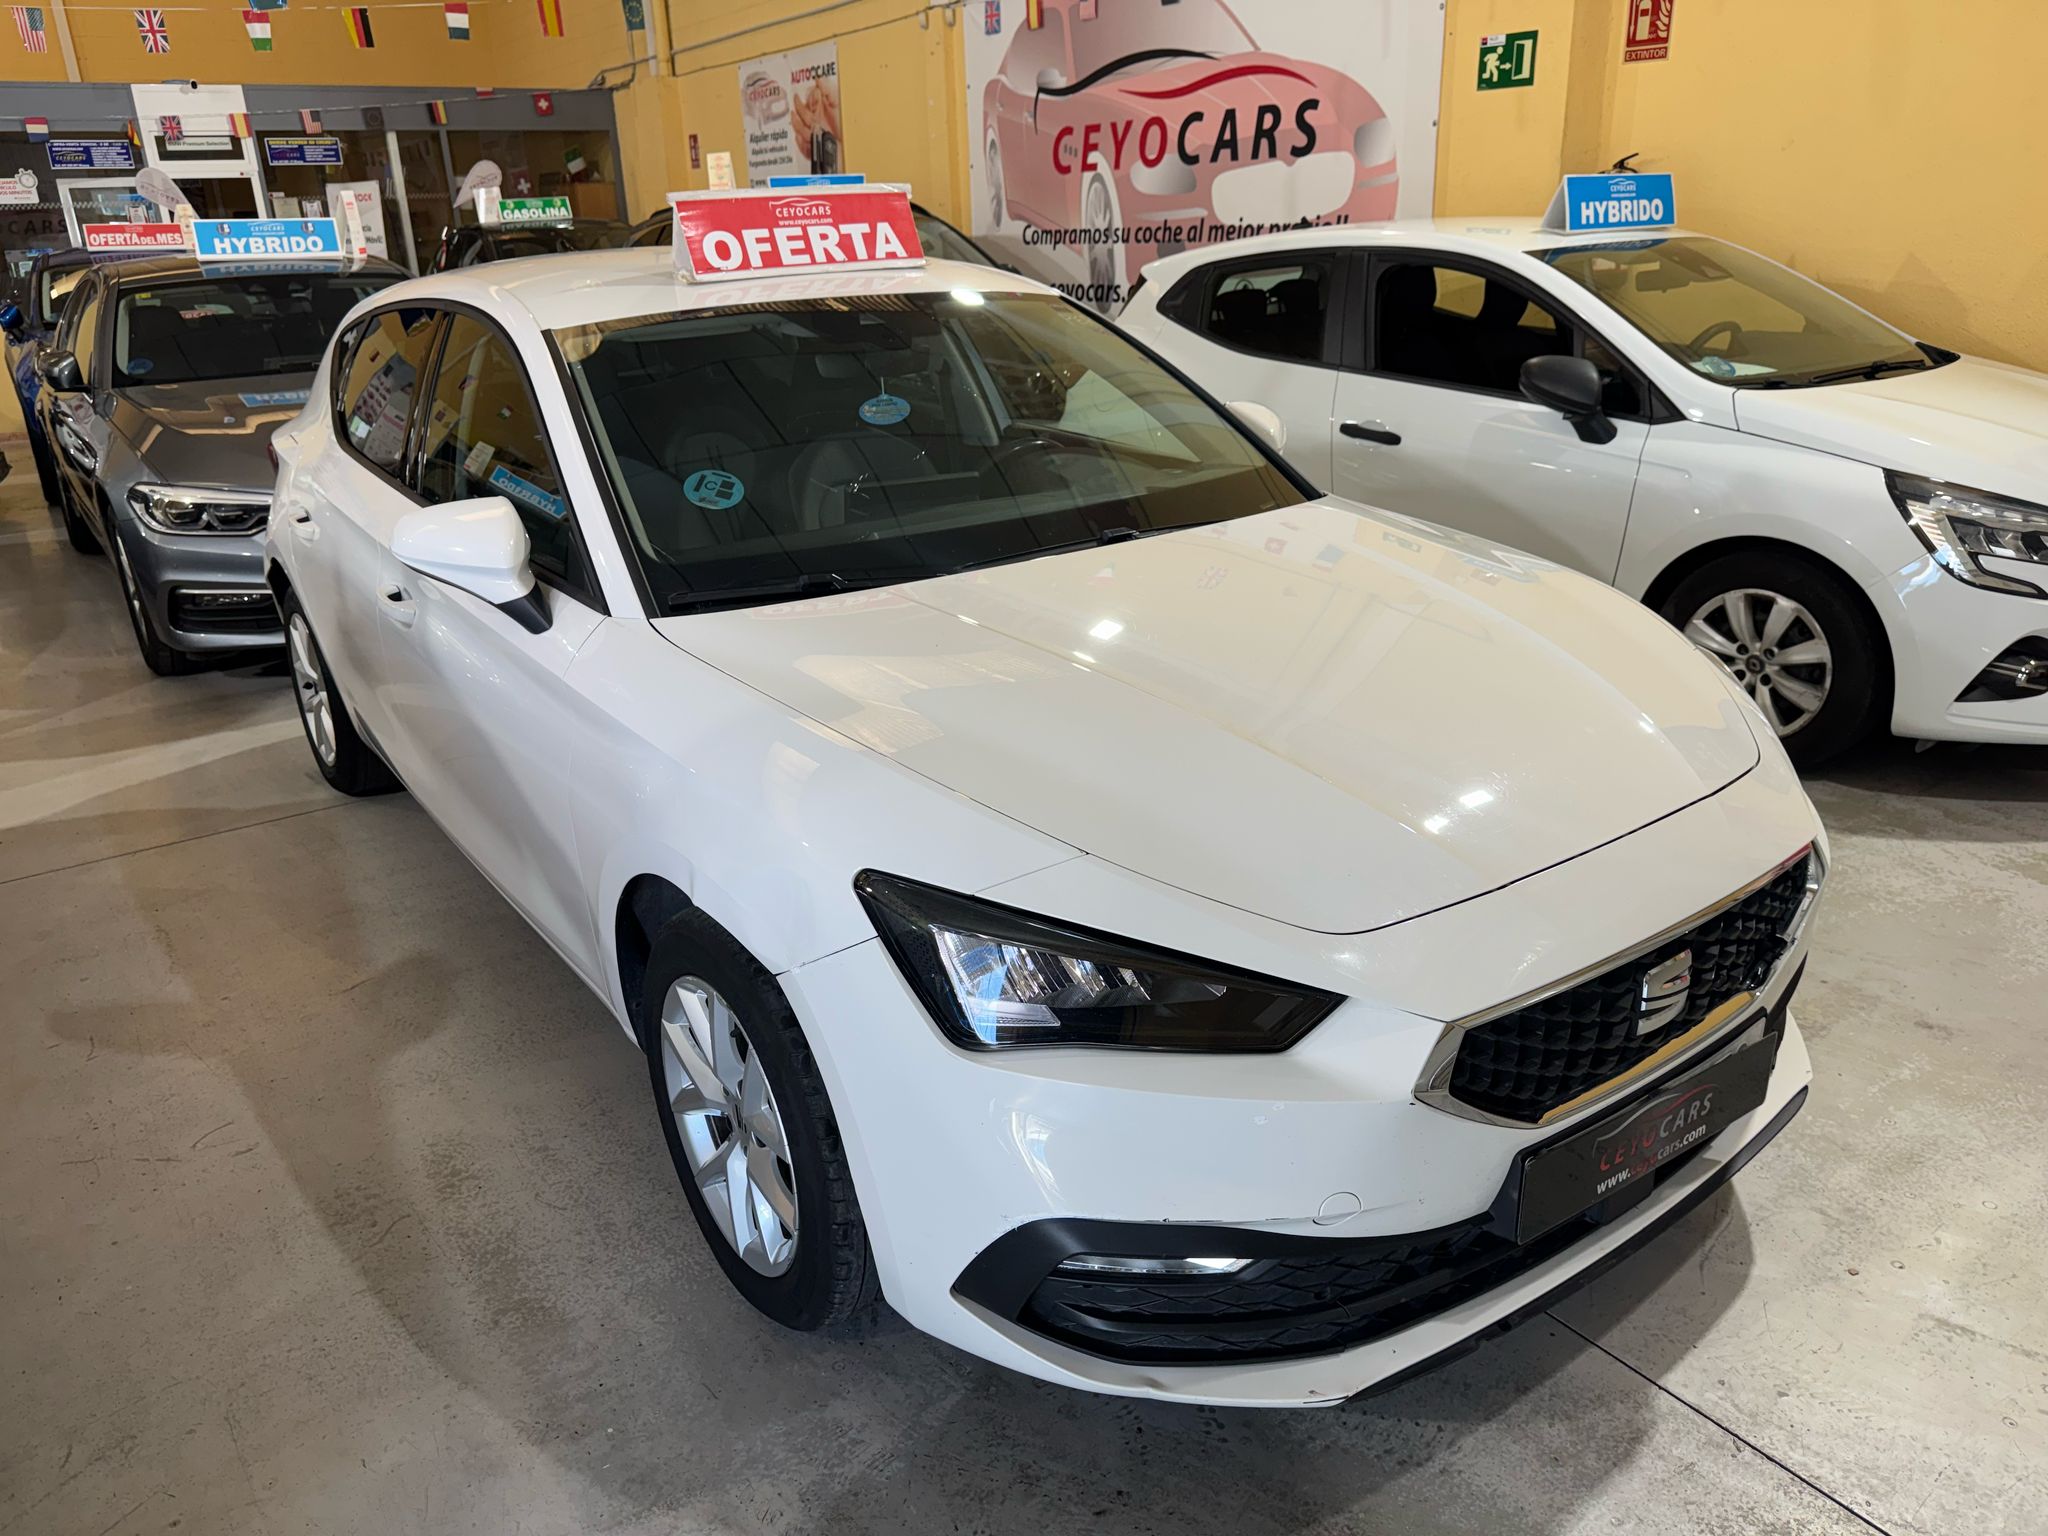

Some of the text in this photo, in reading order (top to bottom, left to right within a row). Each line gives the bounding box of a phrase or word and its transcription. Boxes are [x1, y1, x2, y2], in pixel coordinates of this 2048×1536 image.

[1625, 49, 1667, 61] EXTINTOR
[1053, 99, 1320, 175] CEYOCARS
[1609, 184, 1636, 192] CEYOCARS
[503, 207, 569, 219] GASOLINA
[775, 206, 831, 217] CEYOCARS
[1581, 199, 1664, 225] HYBRIDO
[778, 217, 834, 226] www.ceyocars.com
[89, 232, 183, 246] OFERTA DEL MES
[1022, 223, 1110, 248] Compramos
[1112, 225, 1131, 243] su
[1135, 219, 1183, 243] coche
[1187, 217, 1206, 243] al
[1208, 217, 1264, 243] mejor
[213, 235, 324, 254] HYBRIDO
[702, 221, 908, 271] OFERTA
[704, 481, 718, 491] C
[1600, 1093, 1713, 1171] CEYOCARS
[1597, 1124, 1707, 1194] www.ceyocars.com
